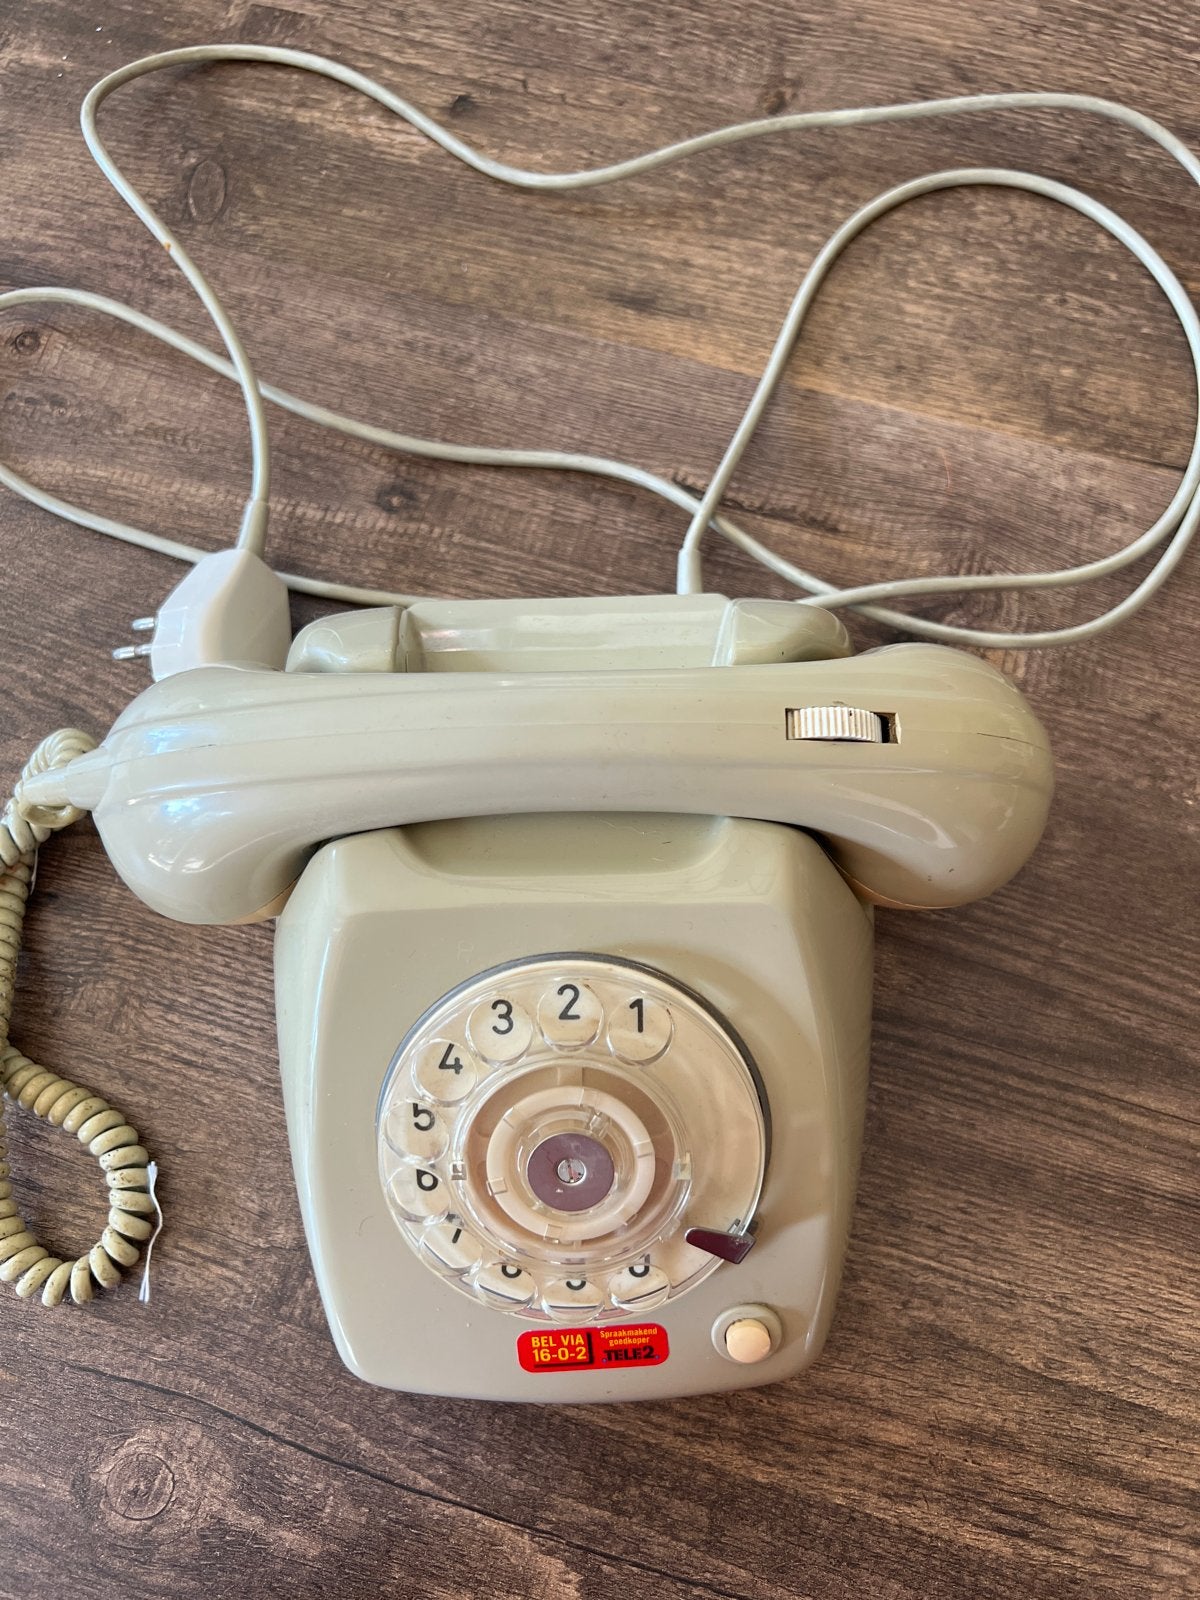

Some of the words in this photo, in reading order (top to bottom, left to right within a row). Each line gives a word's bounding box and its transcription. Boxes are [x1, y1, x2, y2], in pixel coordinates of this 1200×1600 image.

[557, 984, 581, 1020] 2
[491, 999, 514, 1035] 3
[629, 998, 644, 1033] 1
[438, 1043, 463, 1075] 4
[412, 1103, 435, 1131] 5
[531, 1336, 556, 1348] BEL
[561, 1334, 584, 1346] VIA
[600, 1327, 658, 1338] Spraakmakend
[608, 1337, 650, 1347] goedkoper
[532, 1347, 587, 1362] 16-0-2
[604, 1345, 655, 1361] TELE2
